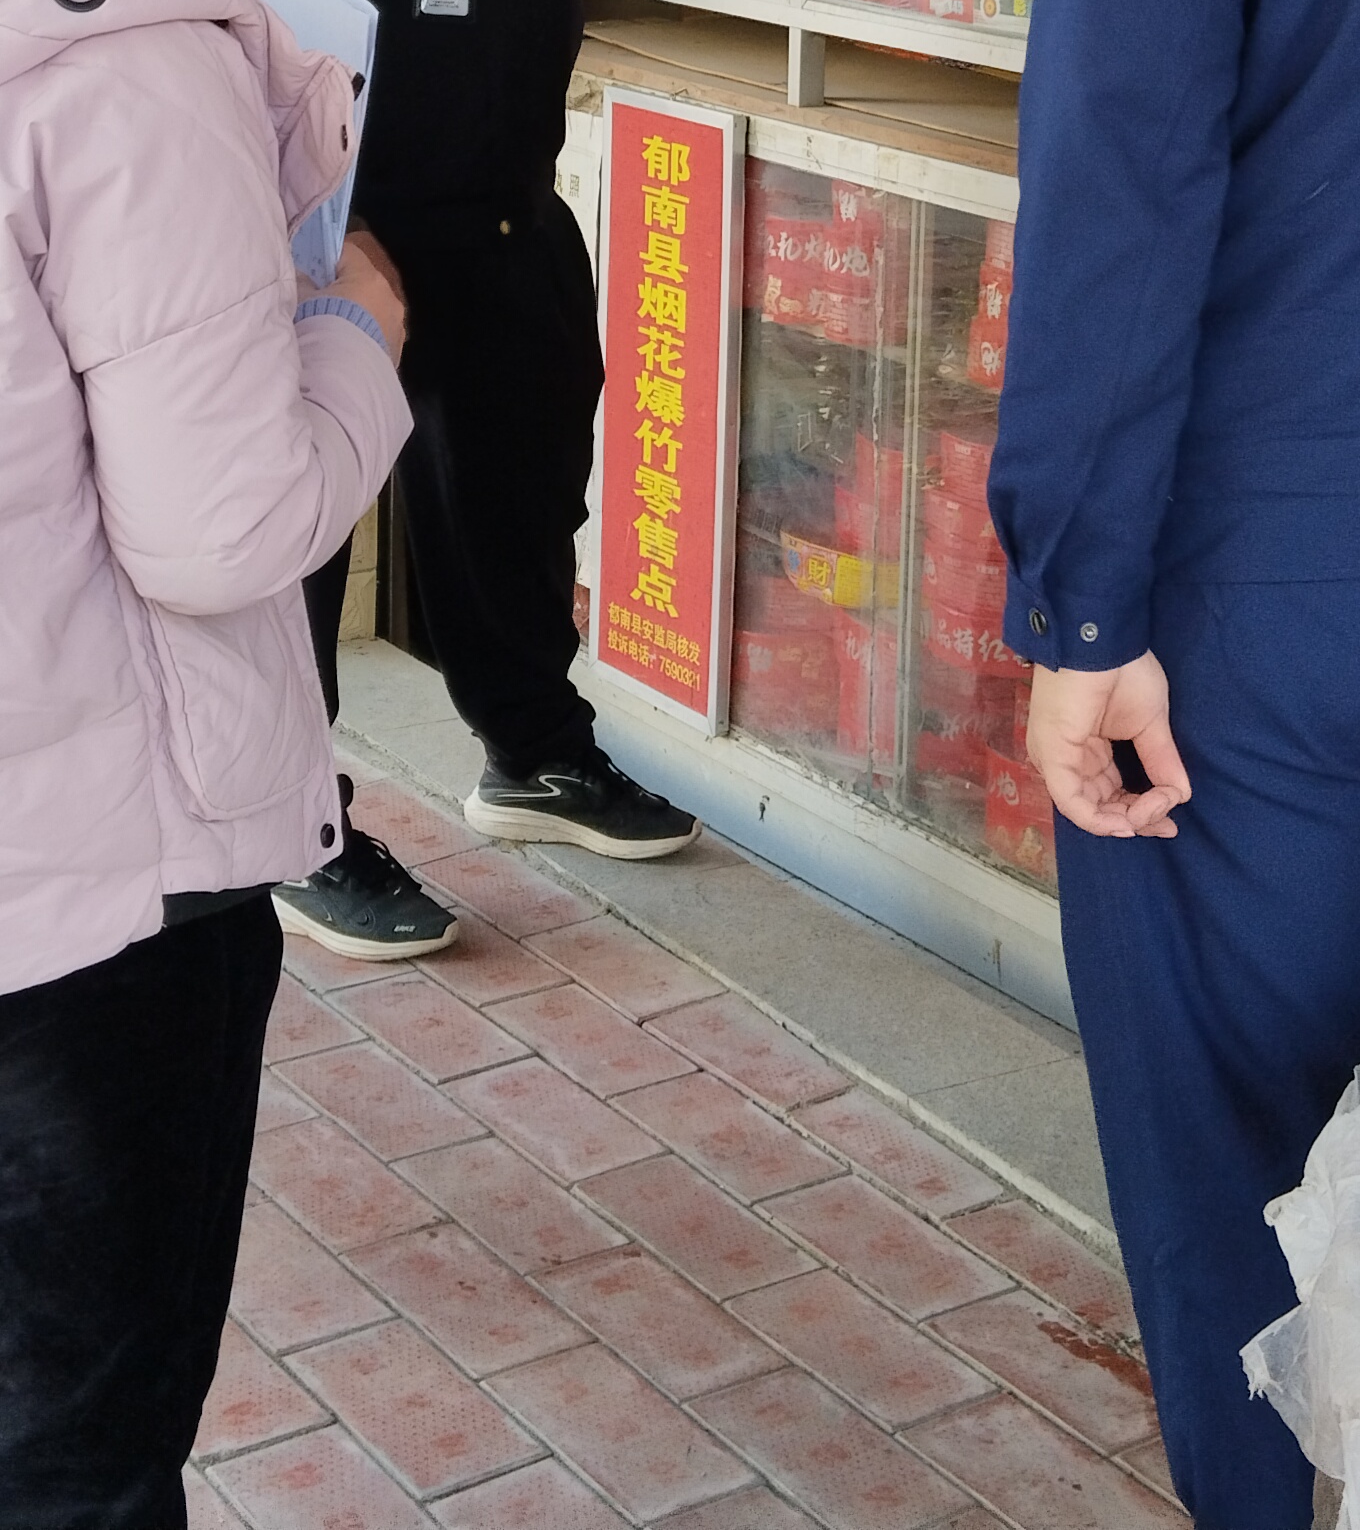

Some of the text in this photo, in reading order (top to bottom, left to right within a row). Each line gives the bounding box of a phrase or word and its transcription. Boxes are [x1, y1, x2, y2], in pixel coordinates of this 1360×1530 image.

[630, 134, 691, 618] 郁南县烟花爆竹零售点
[607, 601, 701, 666] 郁南县安监局核发
